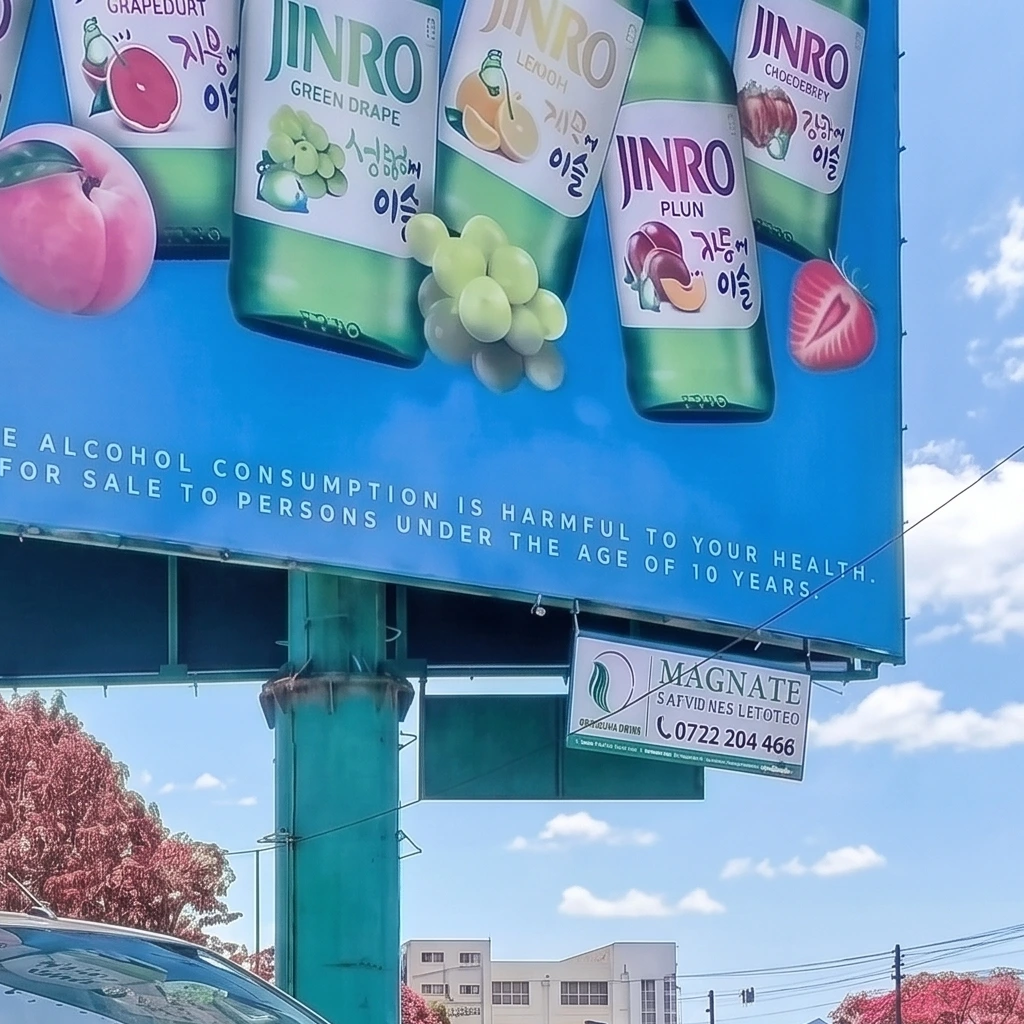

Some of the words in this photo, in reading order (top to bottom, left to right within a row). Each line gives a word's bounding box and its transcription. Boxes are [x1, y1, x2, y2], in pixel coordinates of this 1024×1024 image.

[264, 0, 422, 104] JINRO
[747, 4, 849, 90] JINRO
[291, 80, 344, 110] GREEN
[349, 97, 401, 127] DRAPE
[548, 147, 590, 198] 이슬
[615, 135, 736, 210] JINRO
[660, 201, 704, 217] PLUN
[717, 263, 753, 310] 이슬
[0, 457, 61, 484] FOR
[83, 470, 161, 498] SALE
[180, 483, 218, 506] TO
[238, 491, 376, 528] PERSONS
[396, 515, 492, 546] UNDER
[509, 532, 560, 557] THE
[578, 544, 628, 568] AGE
[645, 556, 676, 576] OF
[692, 564, 718, 583] 10
[733, 569, 819, 599] YEARS.
[39, 433, 191, 473] ALCOHOL
[213, 459, 438, 509] CONSUMPTION
[458, 496, 483, 516] IS
[502, 504, 629, 541] HARMFUL
[646, 528, 676, 549] TO
[692, 536, 757, 563] YOUR
[774, 550, 876, 583] HEALTH.
[659, 659, 801, 705] MAGNATE
[675, 721, 720, 746] 0722
[725, 729, 758, 751] 204
[762, 735, 796, 757] 466
